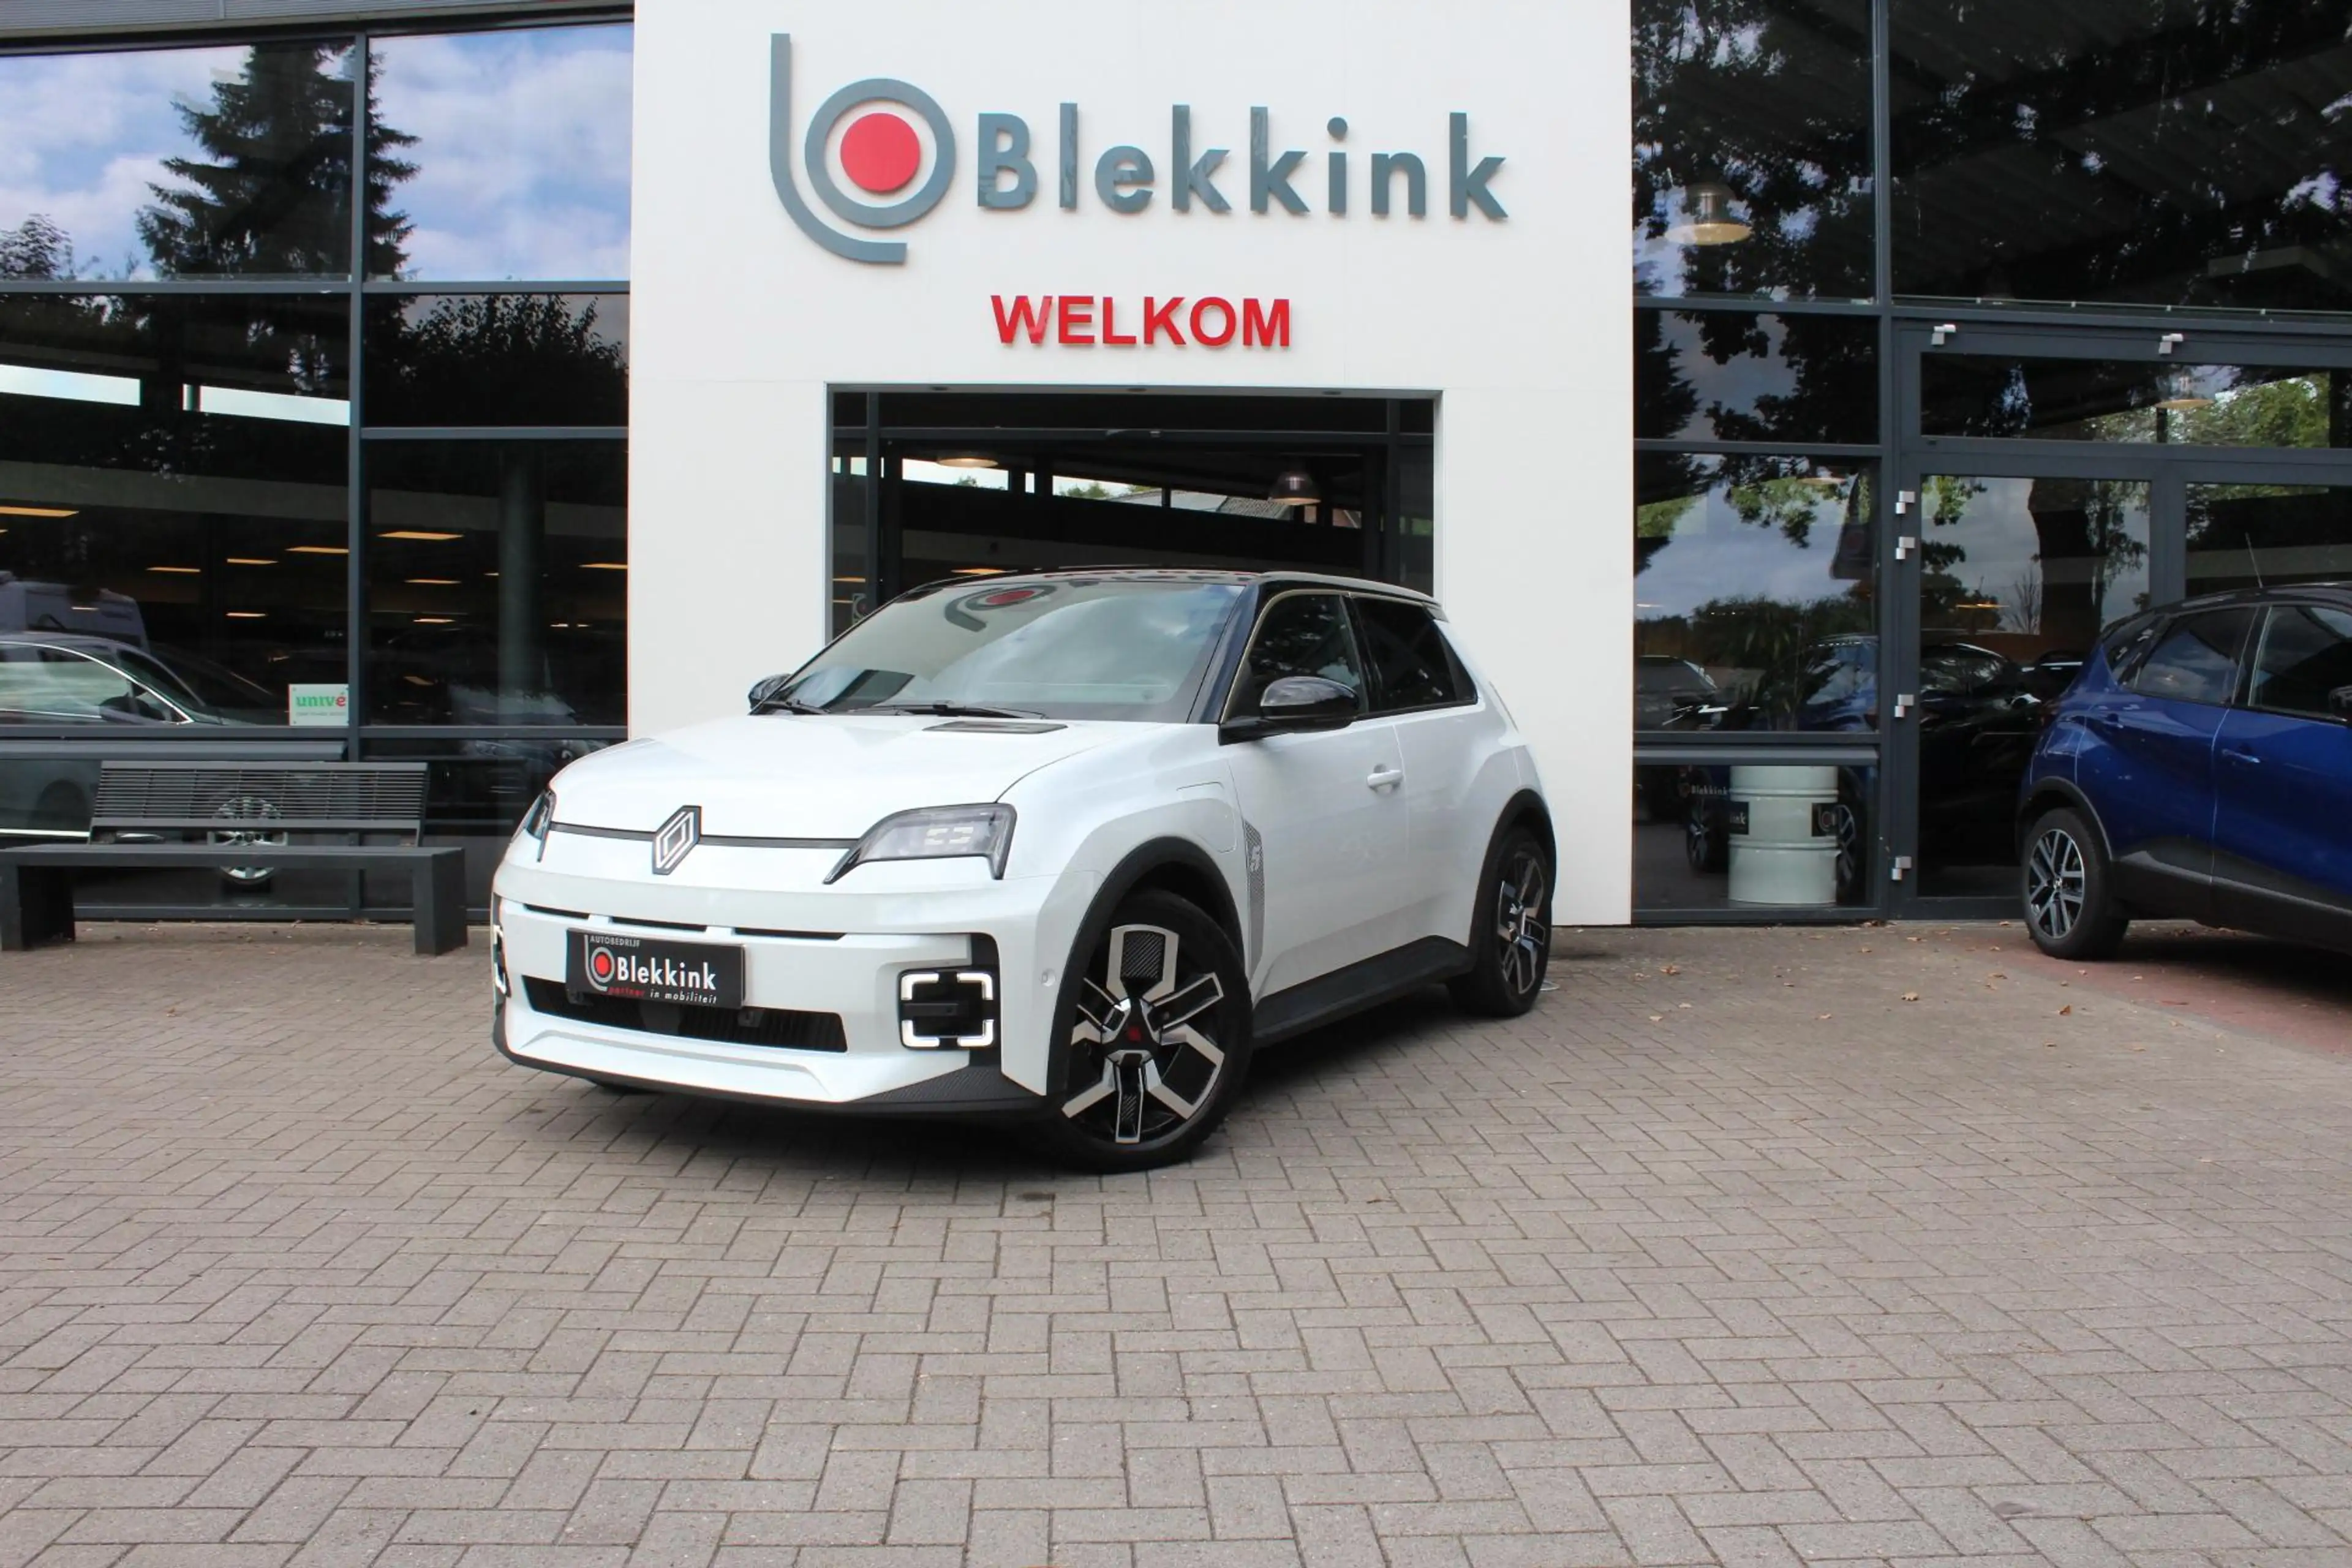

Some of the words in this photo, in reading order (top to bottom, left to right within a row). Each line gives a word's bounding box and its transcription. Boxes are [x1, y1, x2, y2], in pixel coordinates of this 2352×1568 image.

[978, 104, 1507, 219] Blekkink
[992, 295, 1290, 347] WELKOM
[589, 935, 640, 948] AUTOBEDRIJF
[617, 956, 716, 990] Blekkink
[650, 989, 660, 998] in
[665, 991, 717, 1003] mobiliteit
